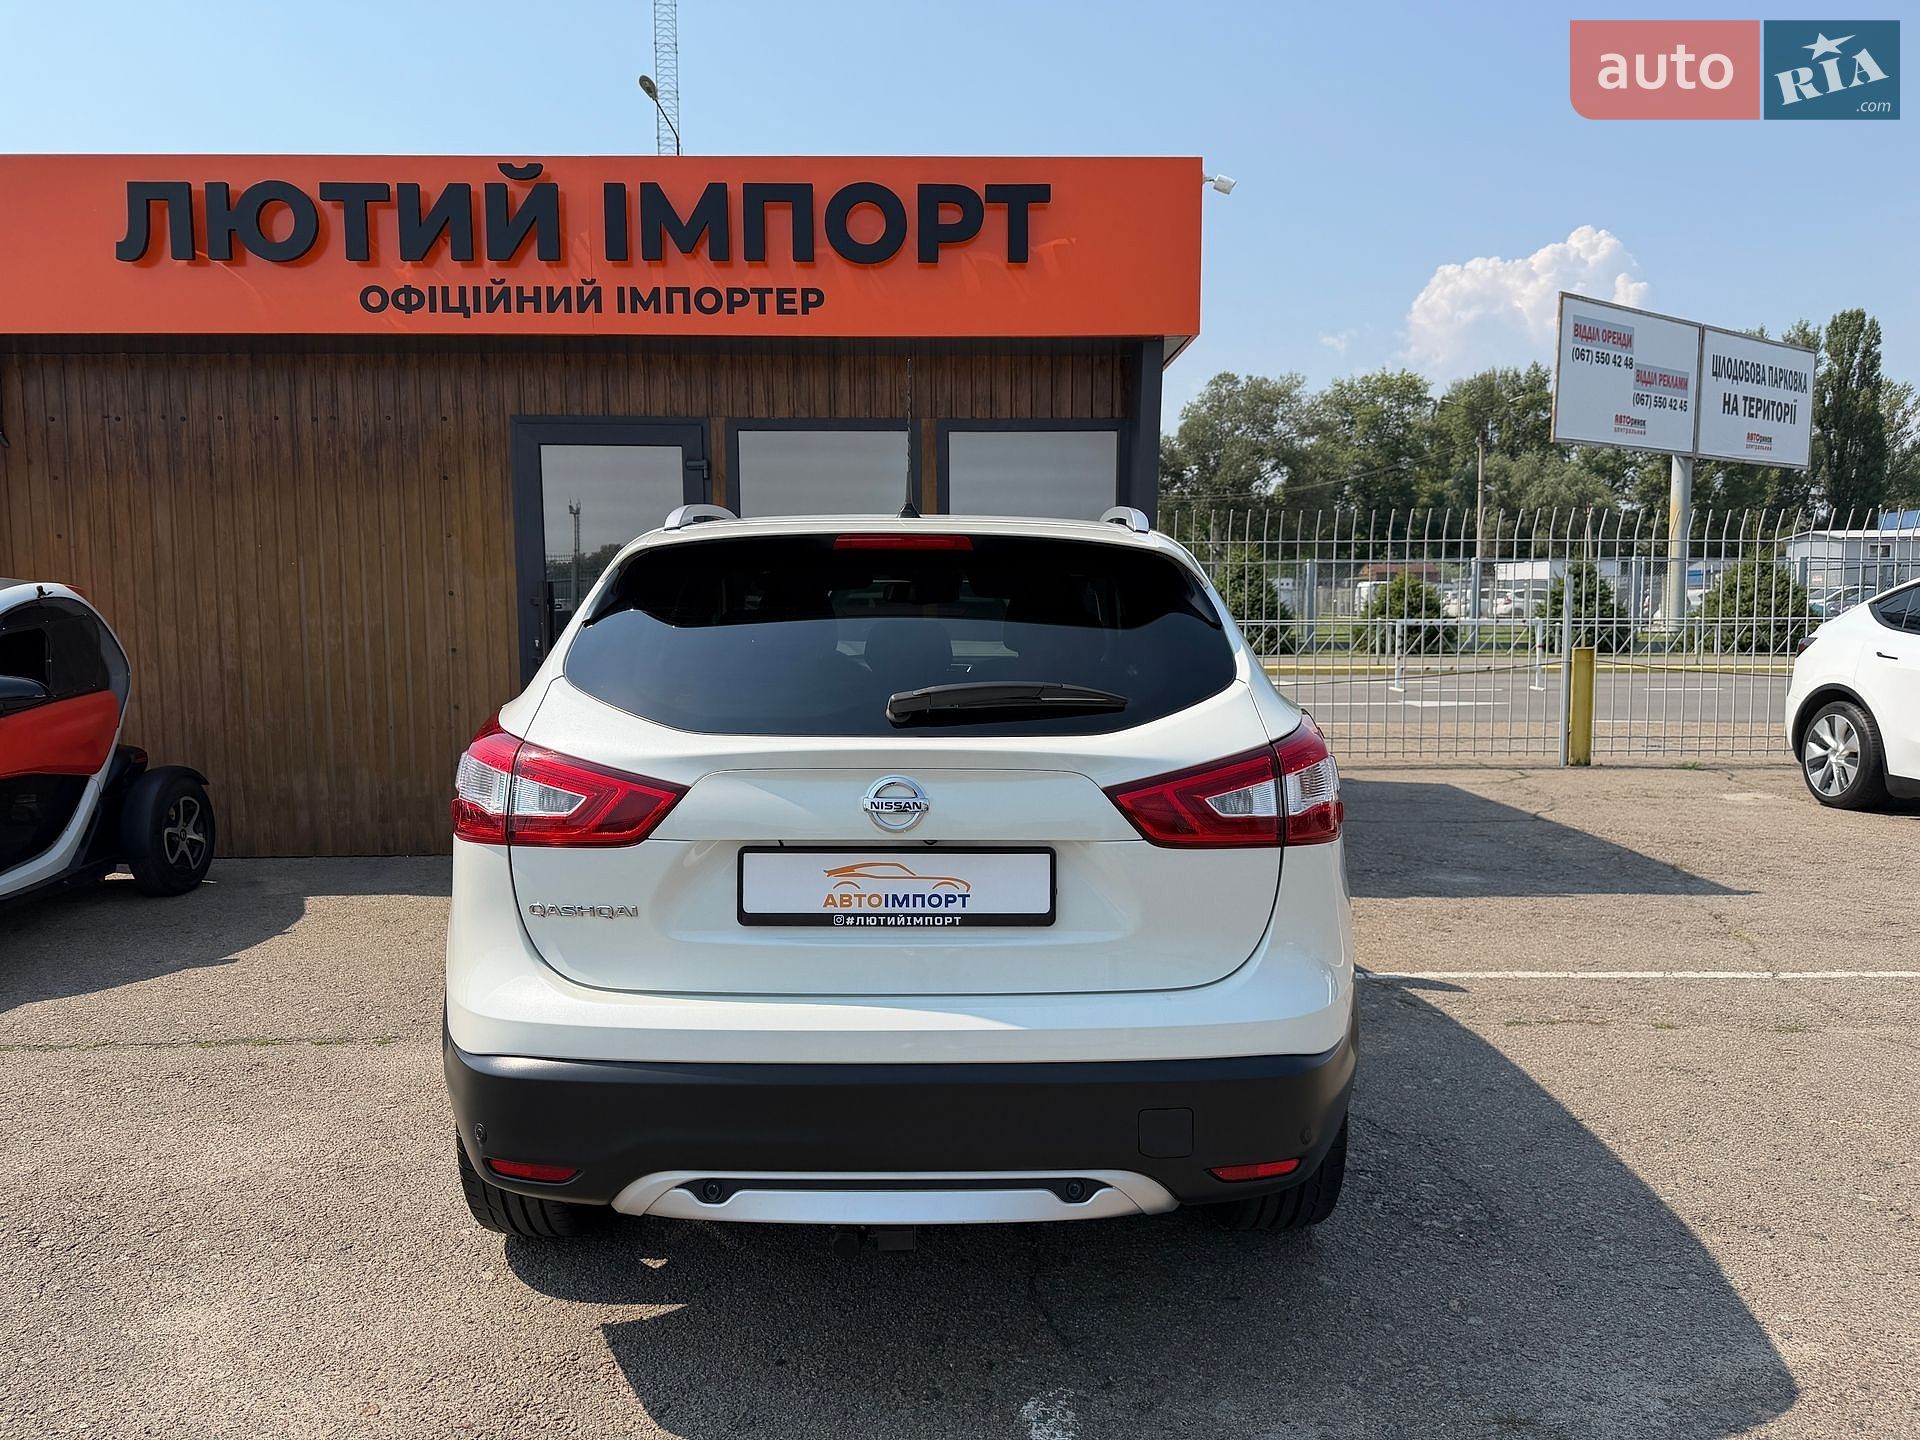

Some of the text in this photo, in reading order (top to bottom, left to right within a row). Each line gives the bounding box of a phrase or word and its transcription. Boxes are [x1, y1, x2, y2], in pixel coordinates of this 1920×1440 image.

[115, 162, 1052, 264] ЛЮТИЙ ІМПОРТ
[359, 278, 826, 319] ОФІЦІЙНИЙ ІМПОРТЕР
[1573, 323, 1633, 349] ВІДДІЛ ОРЕНДИ
[1572, 346, 1634, 370] (067) 550 42 48
[1635, 369, 1689, 391] ВІДДІЛ РЕКЛАМИ
[1712, 353, 1808, 394] ЦІЛОДОБОВА ПАРКОВКА
[1633, 391, 1688, 413] (067) 550 42 45
[1722, 392, 1798, 425] НА ТЕРИТОРІЇ
[869, 800, 923, 812] NISSAN
[528, 902, 639, 919] QASHQAI
[823, 893, 971, 908] АВТОІМПОРТ
[845, 914, 962, 926] #ЛЮТИЙІМПОРТ
